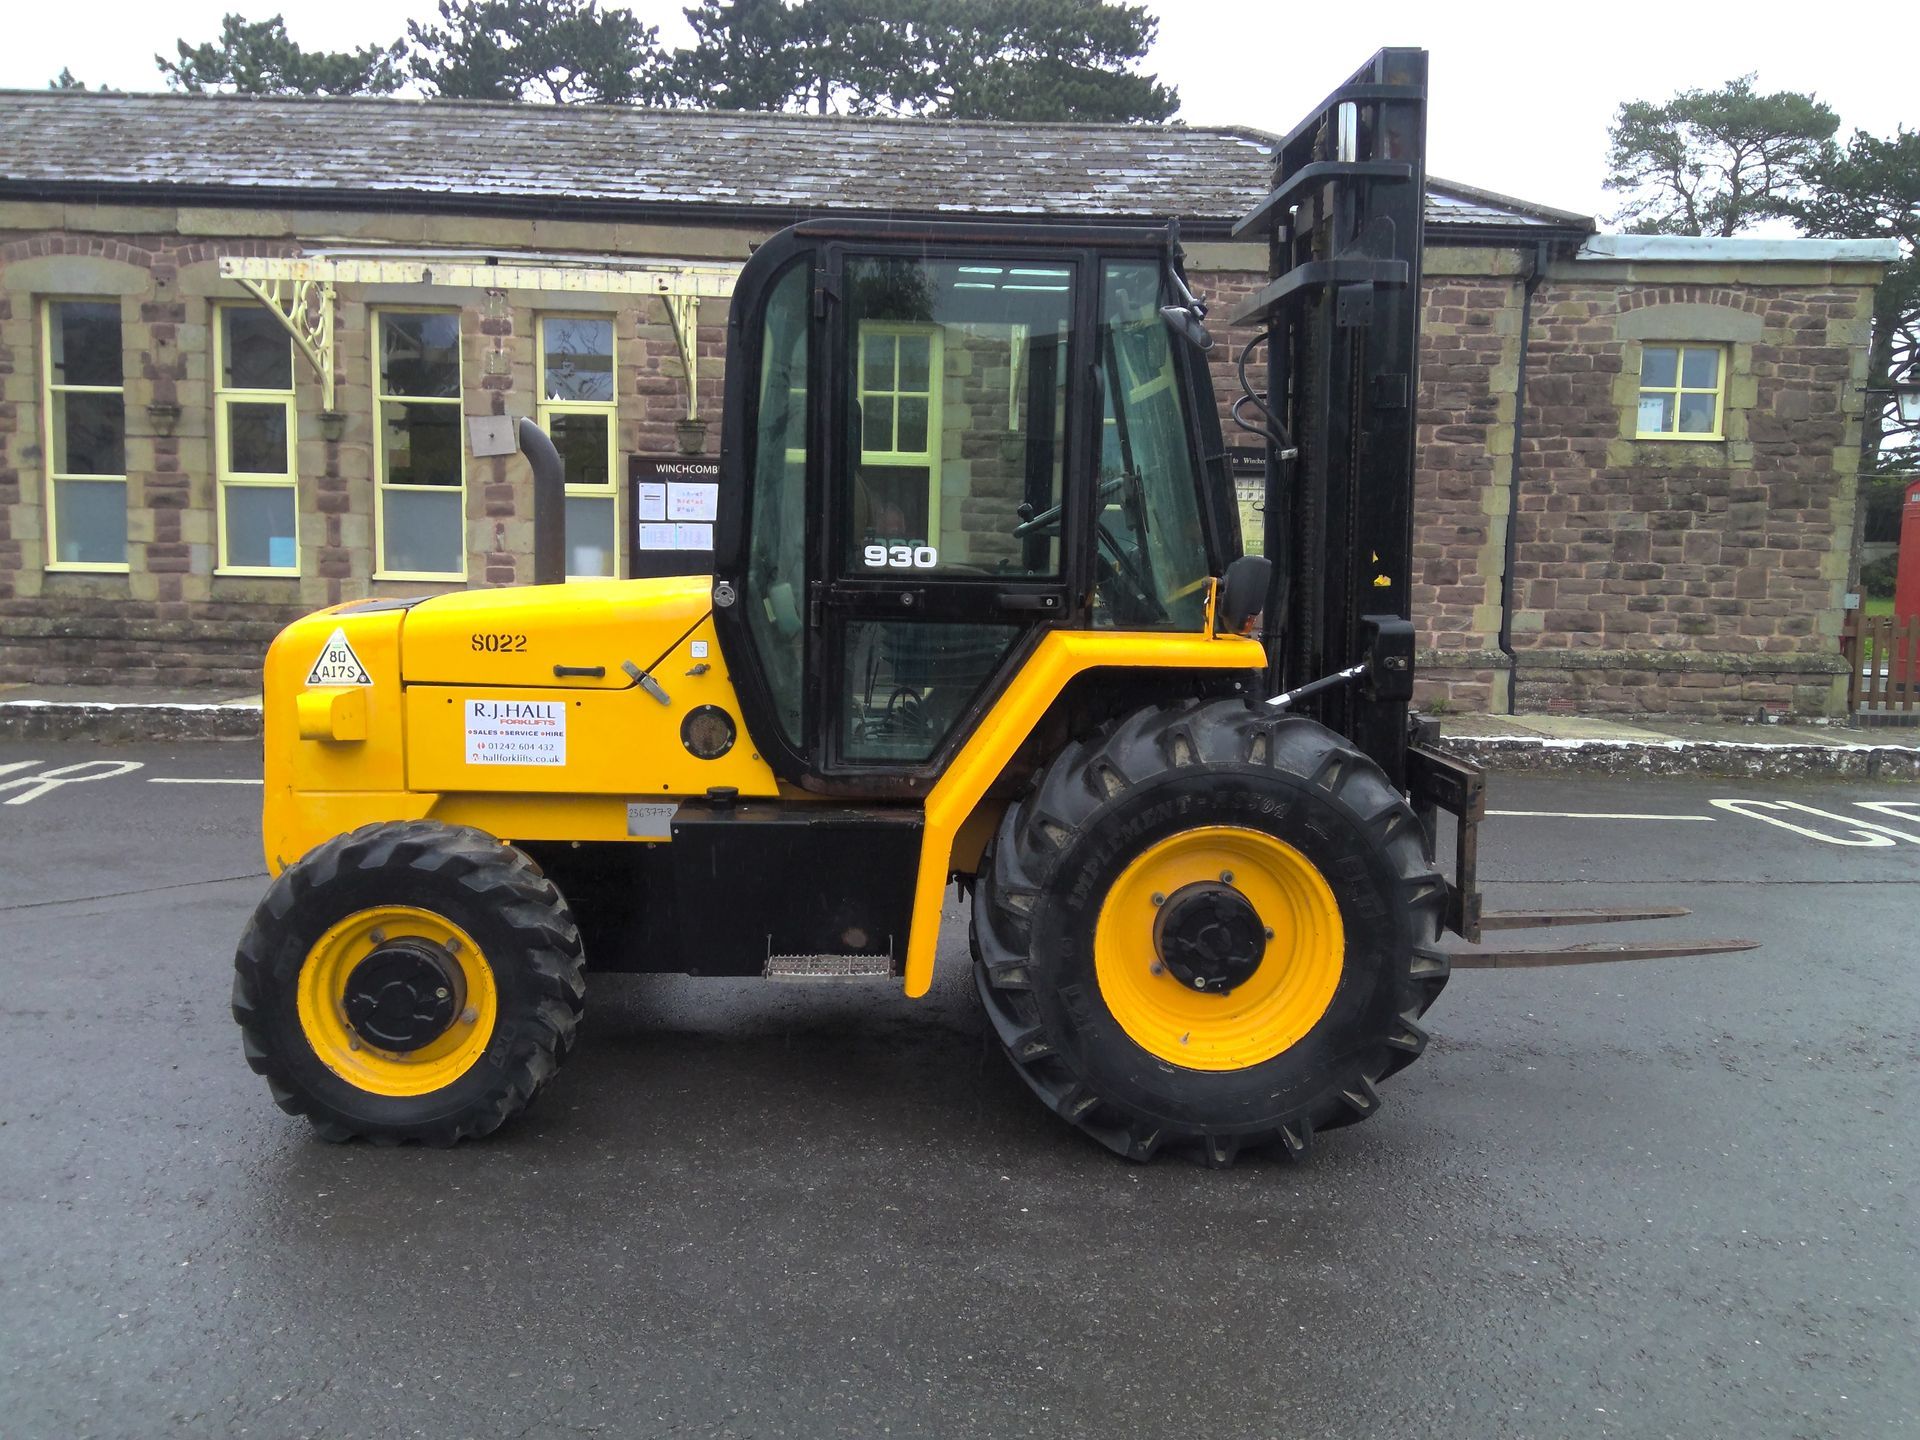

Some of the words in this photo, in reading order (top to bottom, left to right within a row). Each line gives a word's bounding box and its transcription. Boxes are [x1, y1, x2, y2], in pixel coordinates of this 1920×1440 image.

[656, 463, 720, 474] WINCHCOMB
[864, 545, 937, 568] 930
[329, 650, 346, 663] 80
[488, 742, 516, 750] 01242
[518, 743, 535, 751] 604
[537, 743, 554, 751] 432
[482, 753, 560, 763] hallforklifts.co.uk
